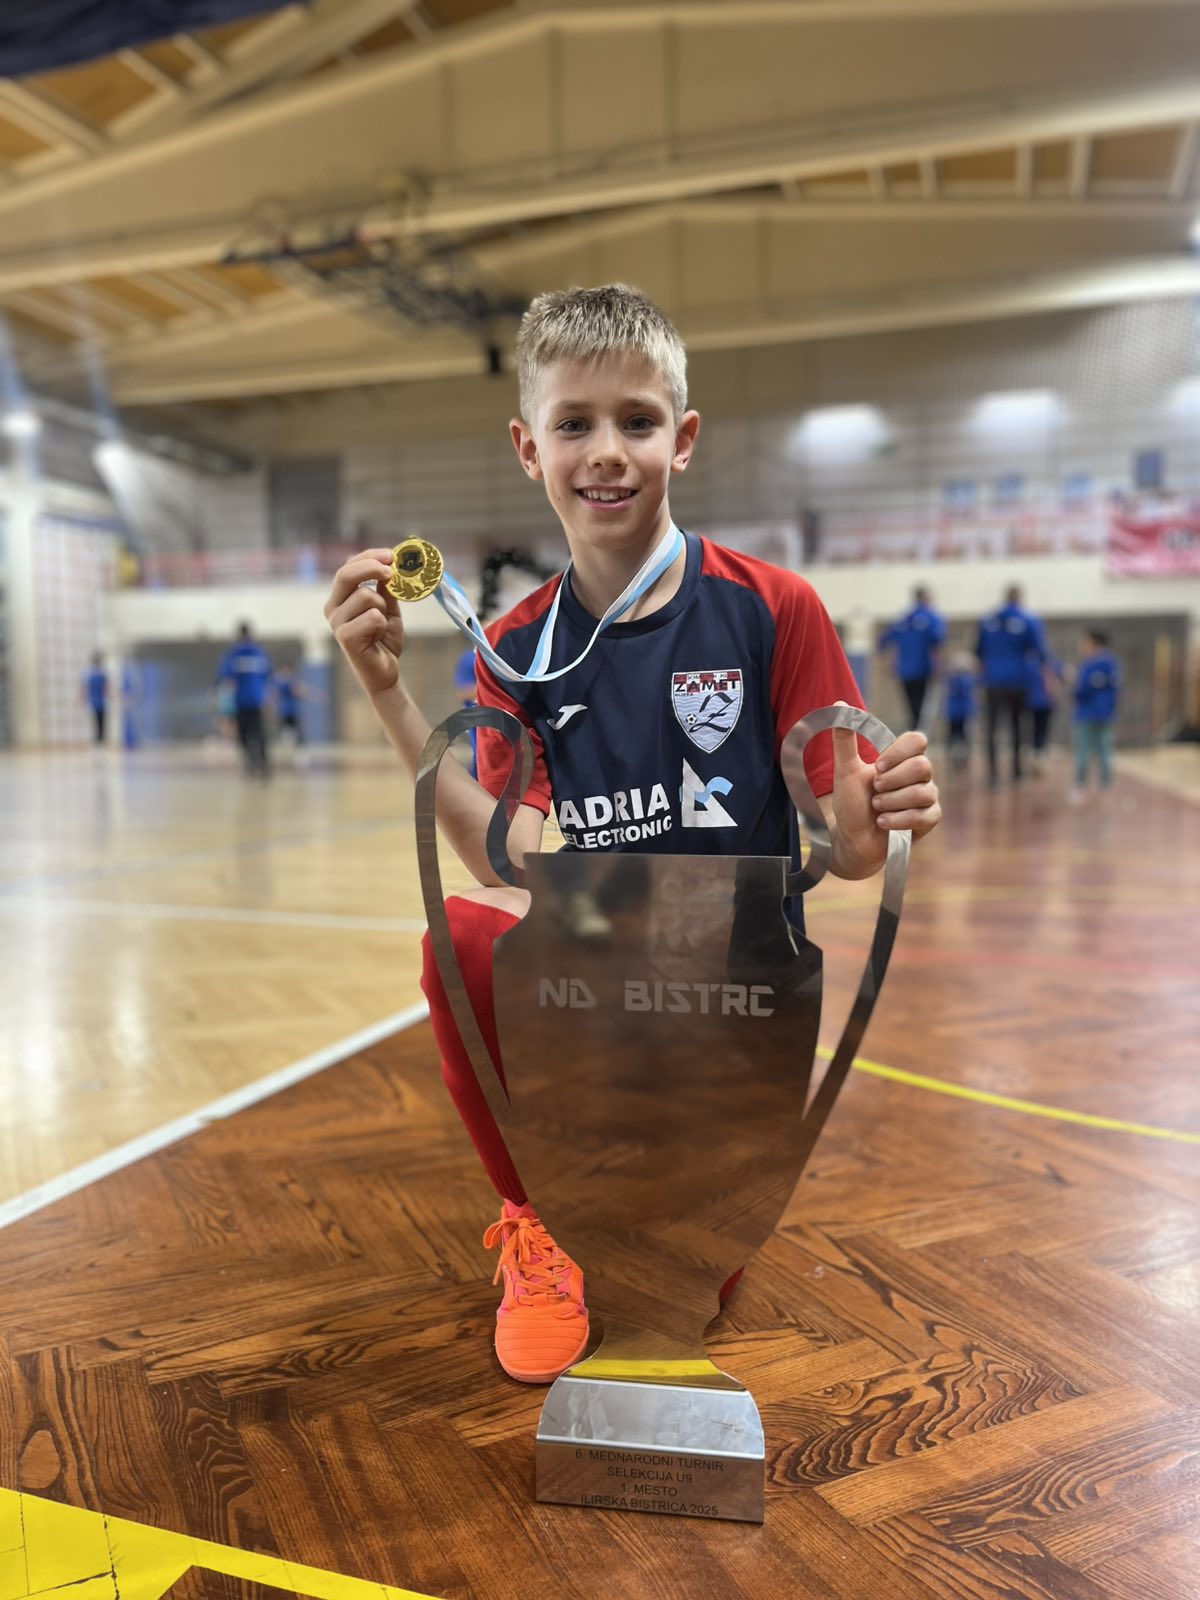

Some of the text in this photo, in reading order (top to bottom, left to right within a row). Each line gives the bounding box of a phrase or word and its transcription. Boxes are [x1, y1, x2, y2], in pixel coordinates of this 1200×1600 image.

[675, 678, 740, 692] ZAMET
[559, 783, 670, 829] ADRIA
[563, 815, 672, 849] ELECTRONIC
[538, 977, 775, 1017] ND BISTRC
[589, 1450, 673, 1467] MEDNARODNI
[678, 1458, 724, 1471] TURNIR
[607, 1467, 692, 1483] SELEKCIJA U9
[634, 1484, 678, 1497] MESTO
[581, 1494, 719, 1516] ILIRSKA BISTRICA 2025
